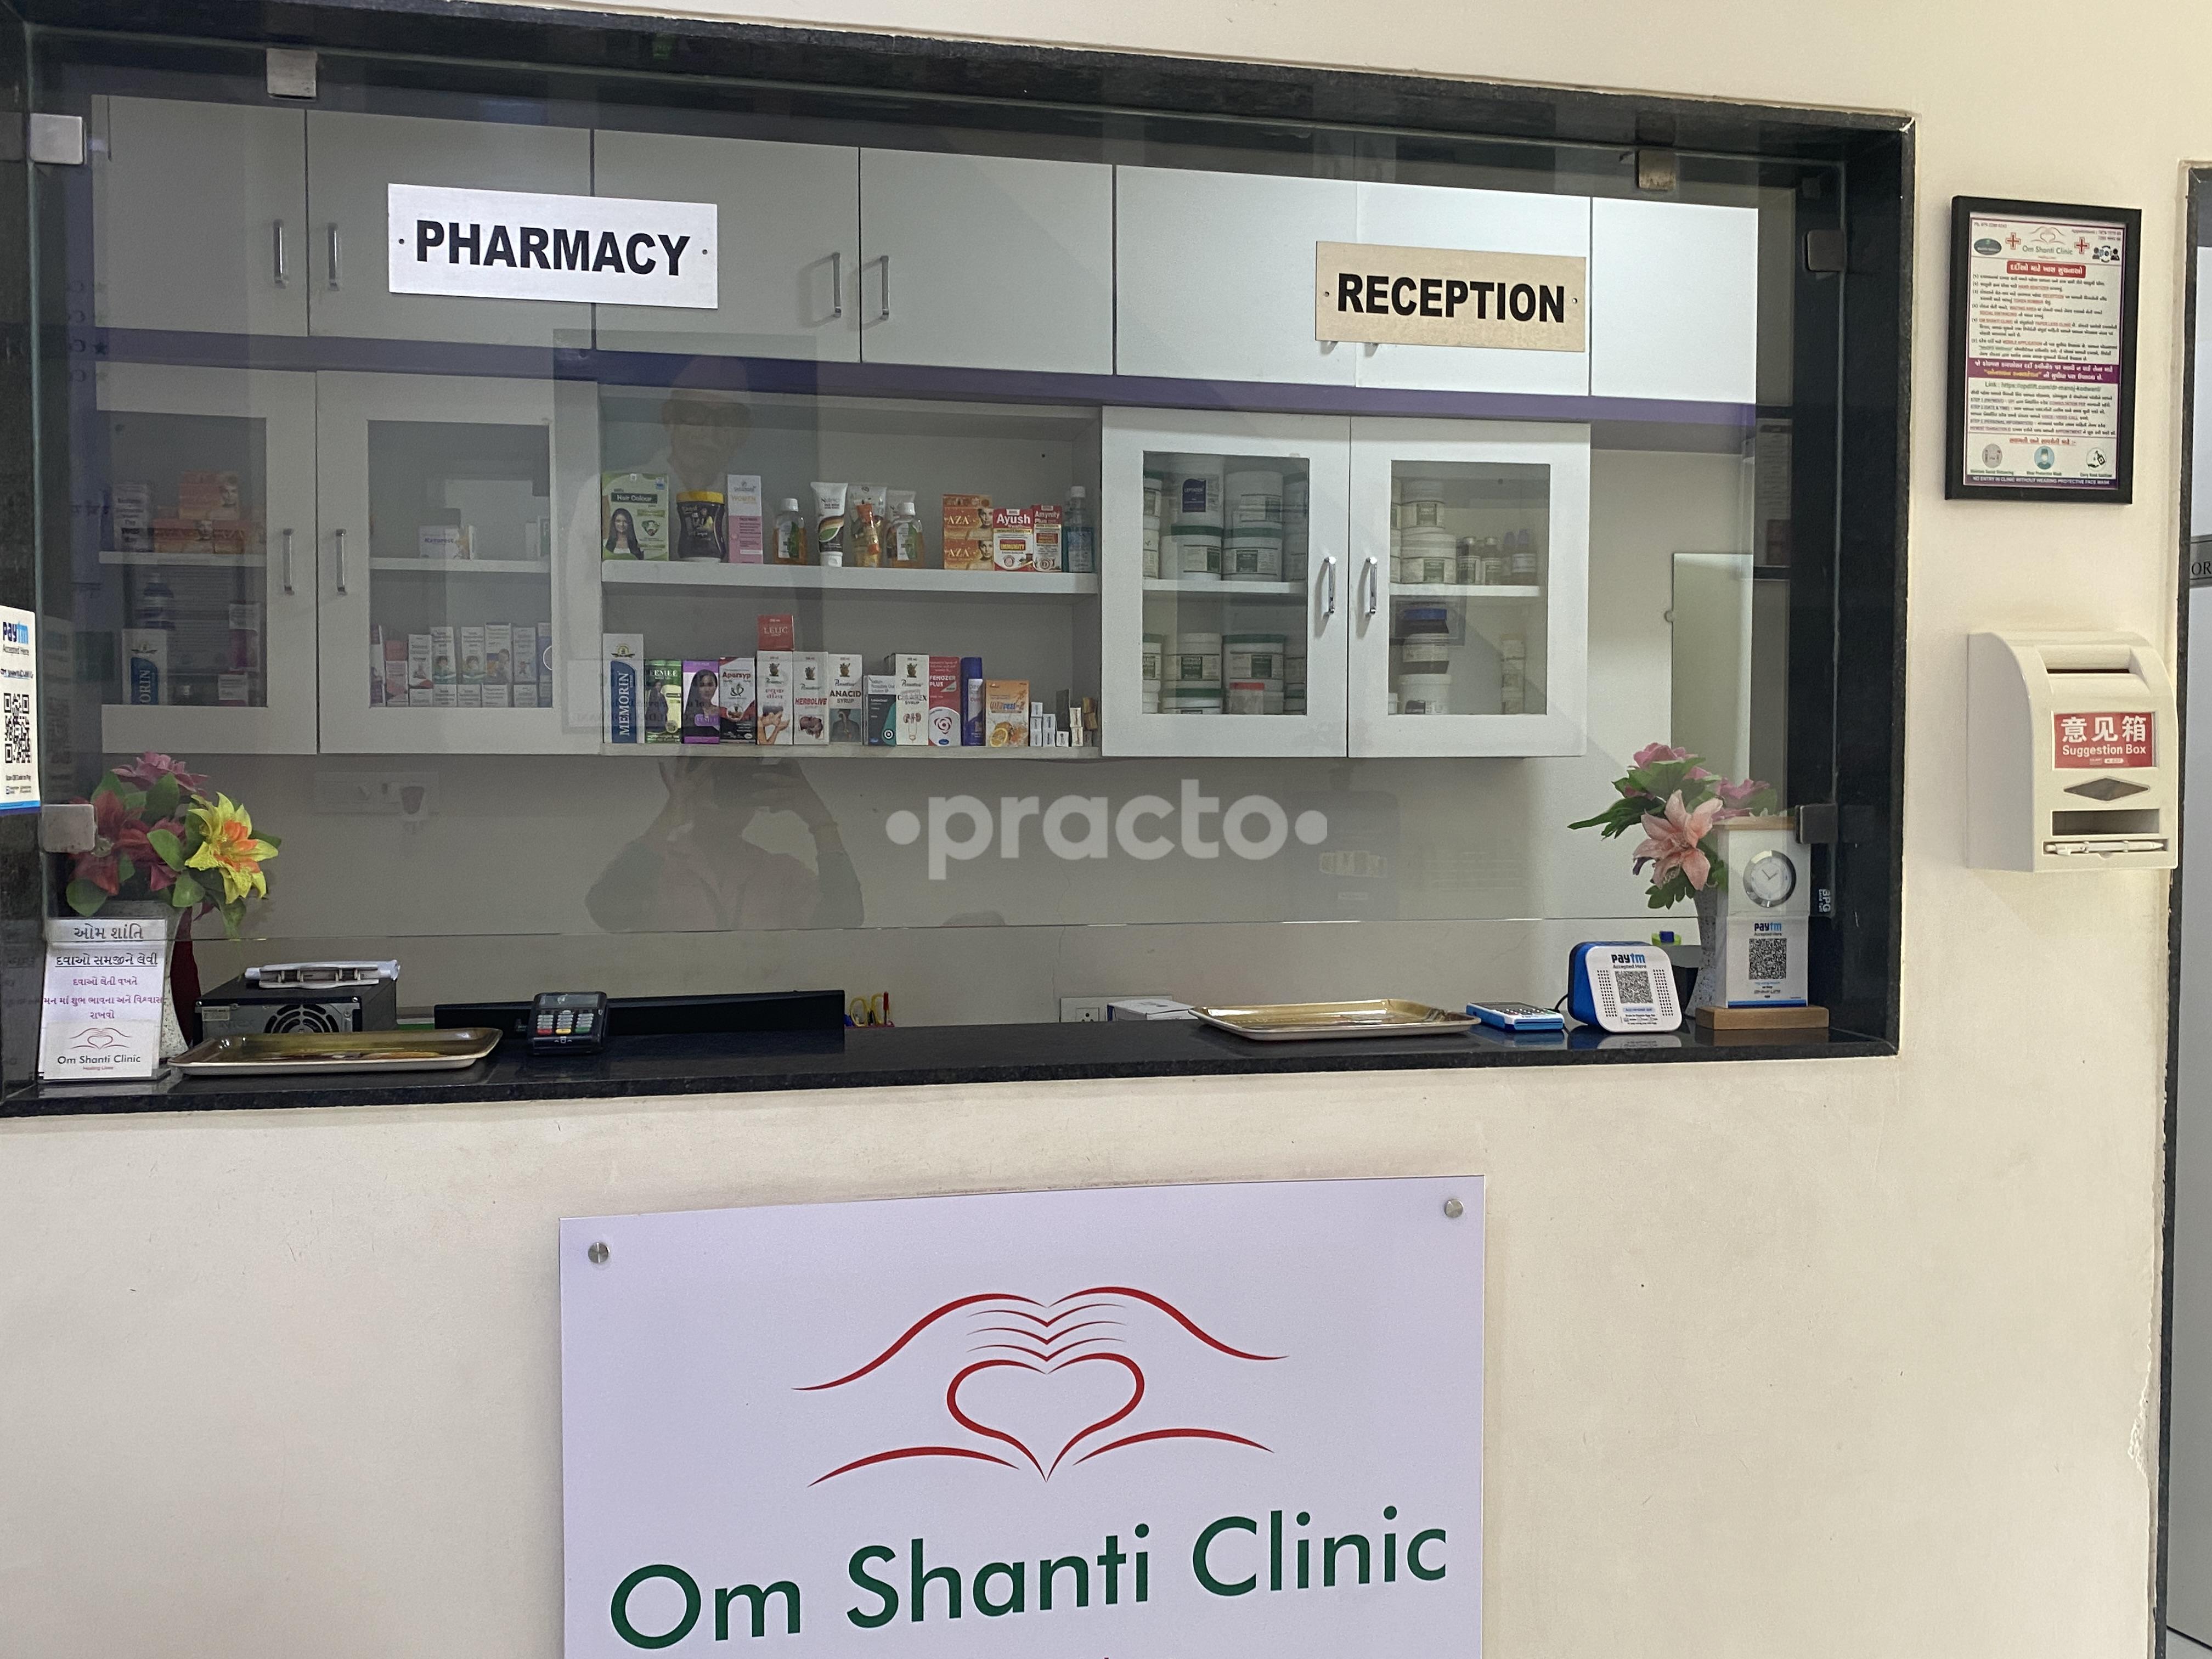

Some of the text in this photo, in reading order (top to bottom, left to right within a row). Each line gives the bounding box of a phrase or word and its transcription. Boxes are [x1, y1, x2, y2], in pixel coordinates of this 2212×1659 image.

[417, 219, 690, 276] PHARMACY
[1338, 273, 1564, 323] RECEPTION
[948, 515, 970, 525] AZA
[997, 513, 1030, 528] Ayush
[949, 548, 970, 557] AZA
[618, 672, 630, 736] MEMORIN
[2061, 715, 2146, 743] 意见箱
[2062, 743, 2146, 757] Suggestion Box
[74, 923, 143, 939] ઓમ શાંતિ
[56, 952, 158, 966] દવાઓ સમજીને લેવી
[73, 977, 138, 986] દવાઓ લેતી વખતે
[59, 995, 69, 1005] માં
[71, 997, 86, 1007] શુભ
[117, 995, 131, 1005] અને
[90, 1010, 115, 1019] રાખવો
[58, 1054, 141, 1064] Om Shanti Clinic
[611, 1506, 1446, 1649] Om Shanti Clinic
